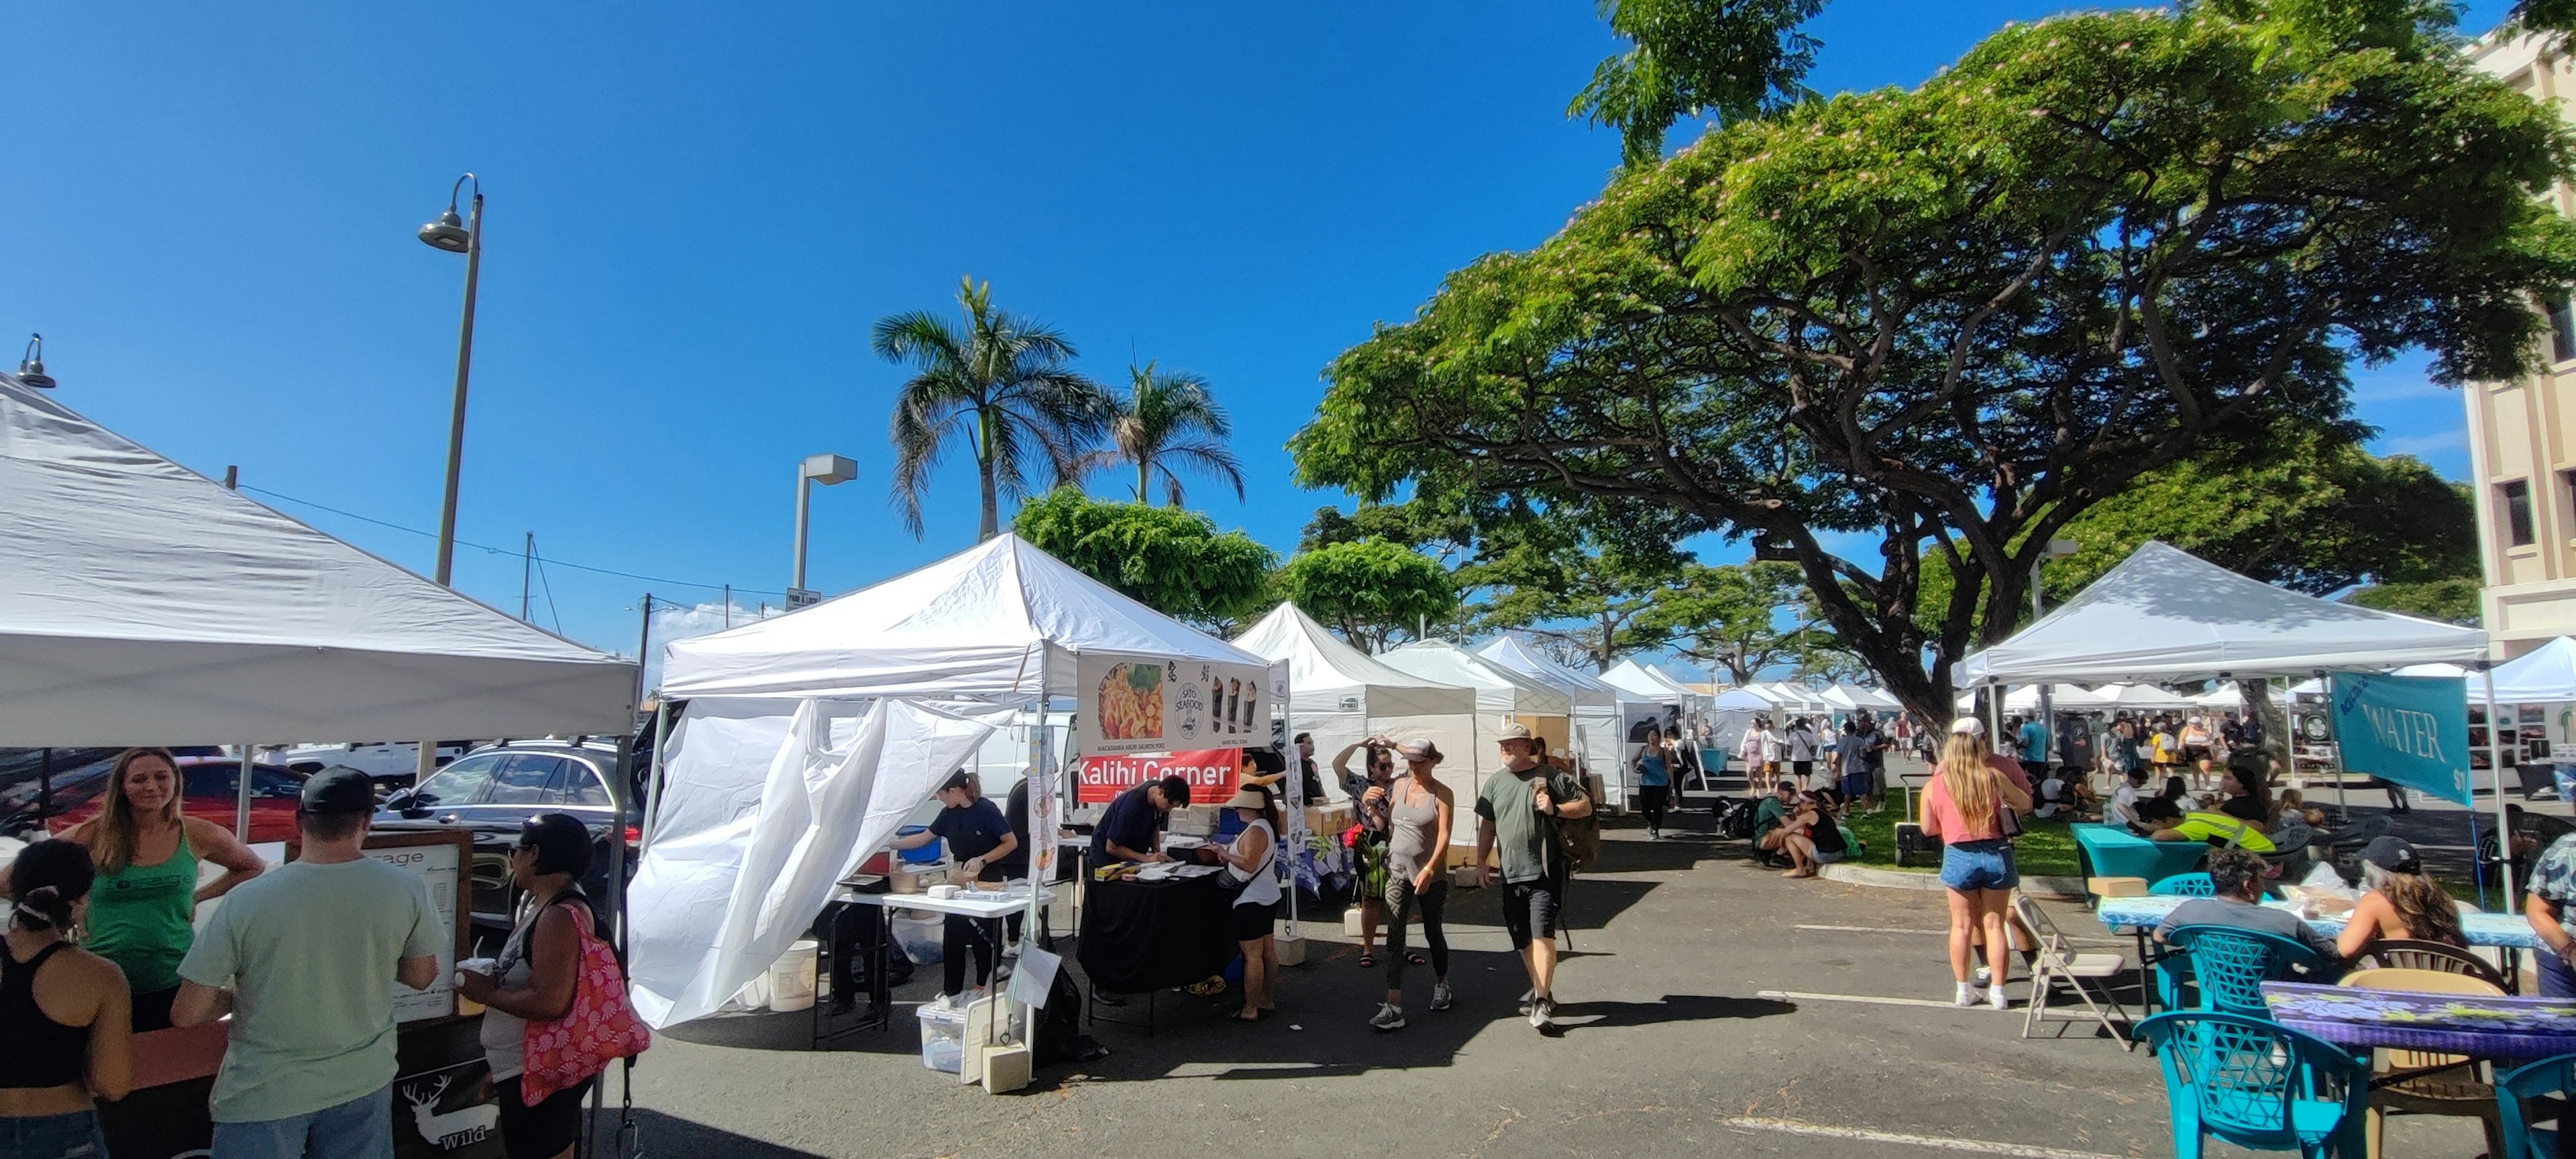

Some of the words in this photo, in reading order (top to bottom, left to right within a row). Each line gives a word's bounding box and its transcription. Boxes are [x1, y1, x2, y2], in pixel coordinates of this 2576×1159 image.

[1182, 689, 1197, 698] SATO
[1176, 700, 1203, 712] SEAFOOD
[2362, 704, 2447, 763] WATER
[1079, 761, 1137, 785] Kalihi
[441, 1126, 486, 1150] Wild
